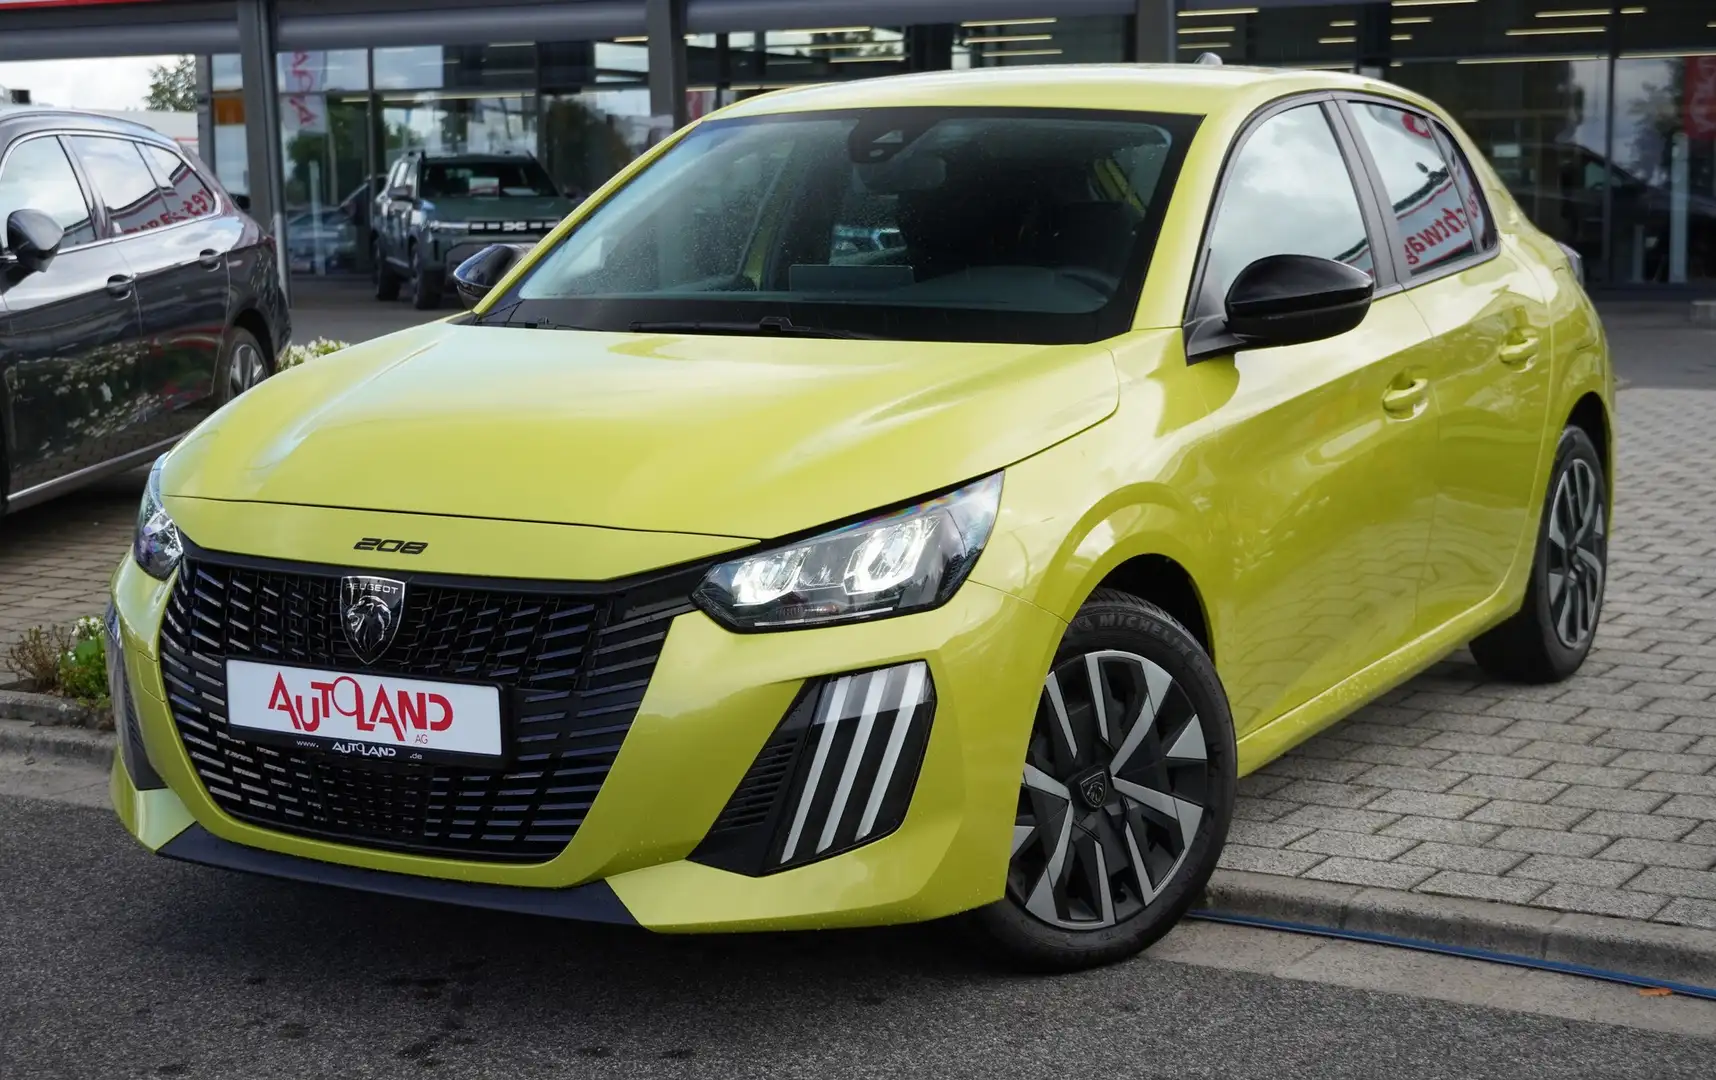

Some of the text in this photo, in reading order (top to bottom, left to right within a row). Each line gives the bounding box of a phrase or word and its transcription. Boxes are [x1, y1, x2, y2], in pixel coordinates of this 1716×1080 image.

[353, 537, 429, 555] 208
[345, 583, 399, 594] PEUGEOT
[1100, 613, 1192, 656] MICHELIN
[268, 671, 454, 742] AUTOLAND
[414, 734, 429, 745] AG
[296, 740, 320, 749] www.
[332, 741, 397, 758] AUTOLAND
